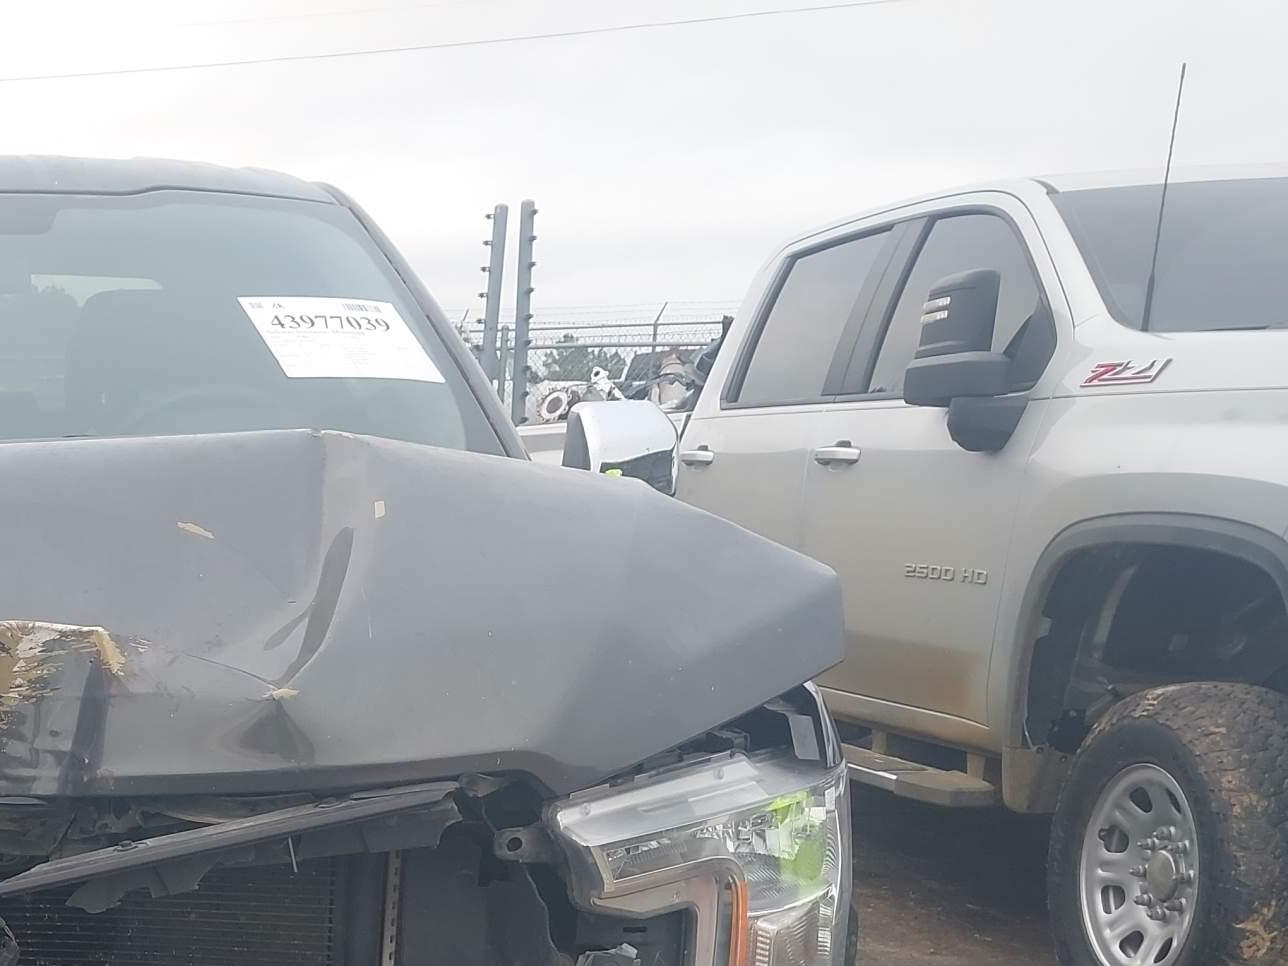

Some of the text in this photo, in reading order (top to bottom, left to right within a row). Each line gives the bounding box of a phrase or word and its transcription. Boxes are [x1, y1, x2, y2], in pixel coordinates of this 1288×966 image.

[271, 314, 390, 332] 43977039
[904, 563, 987, 584] 2500 HD
